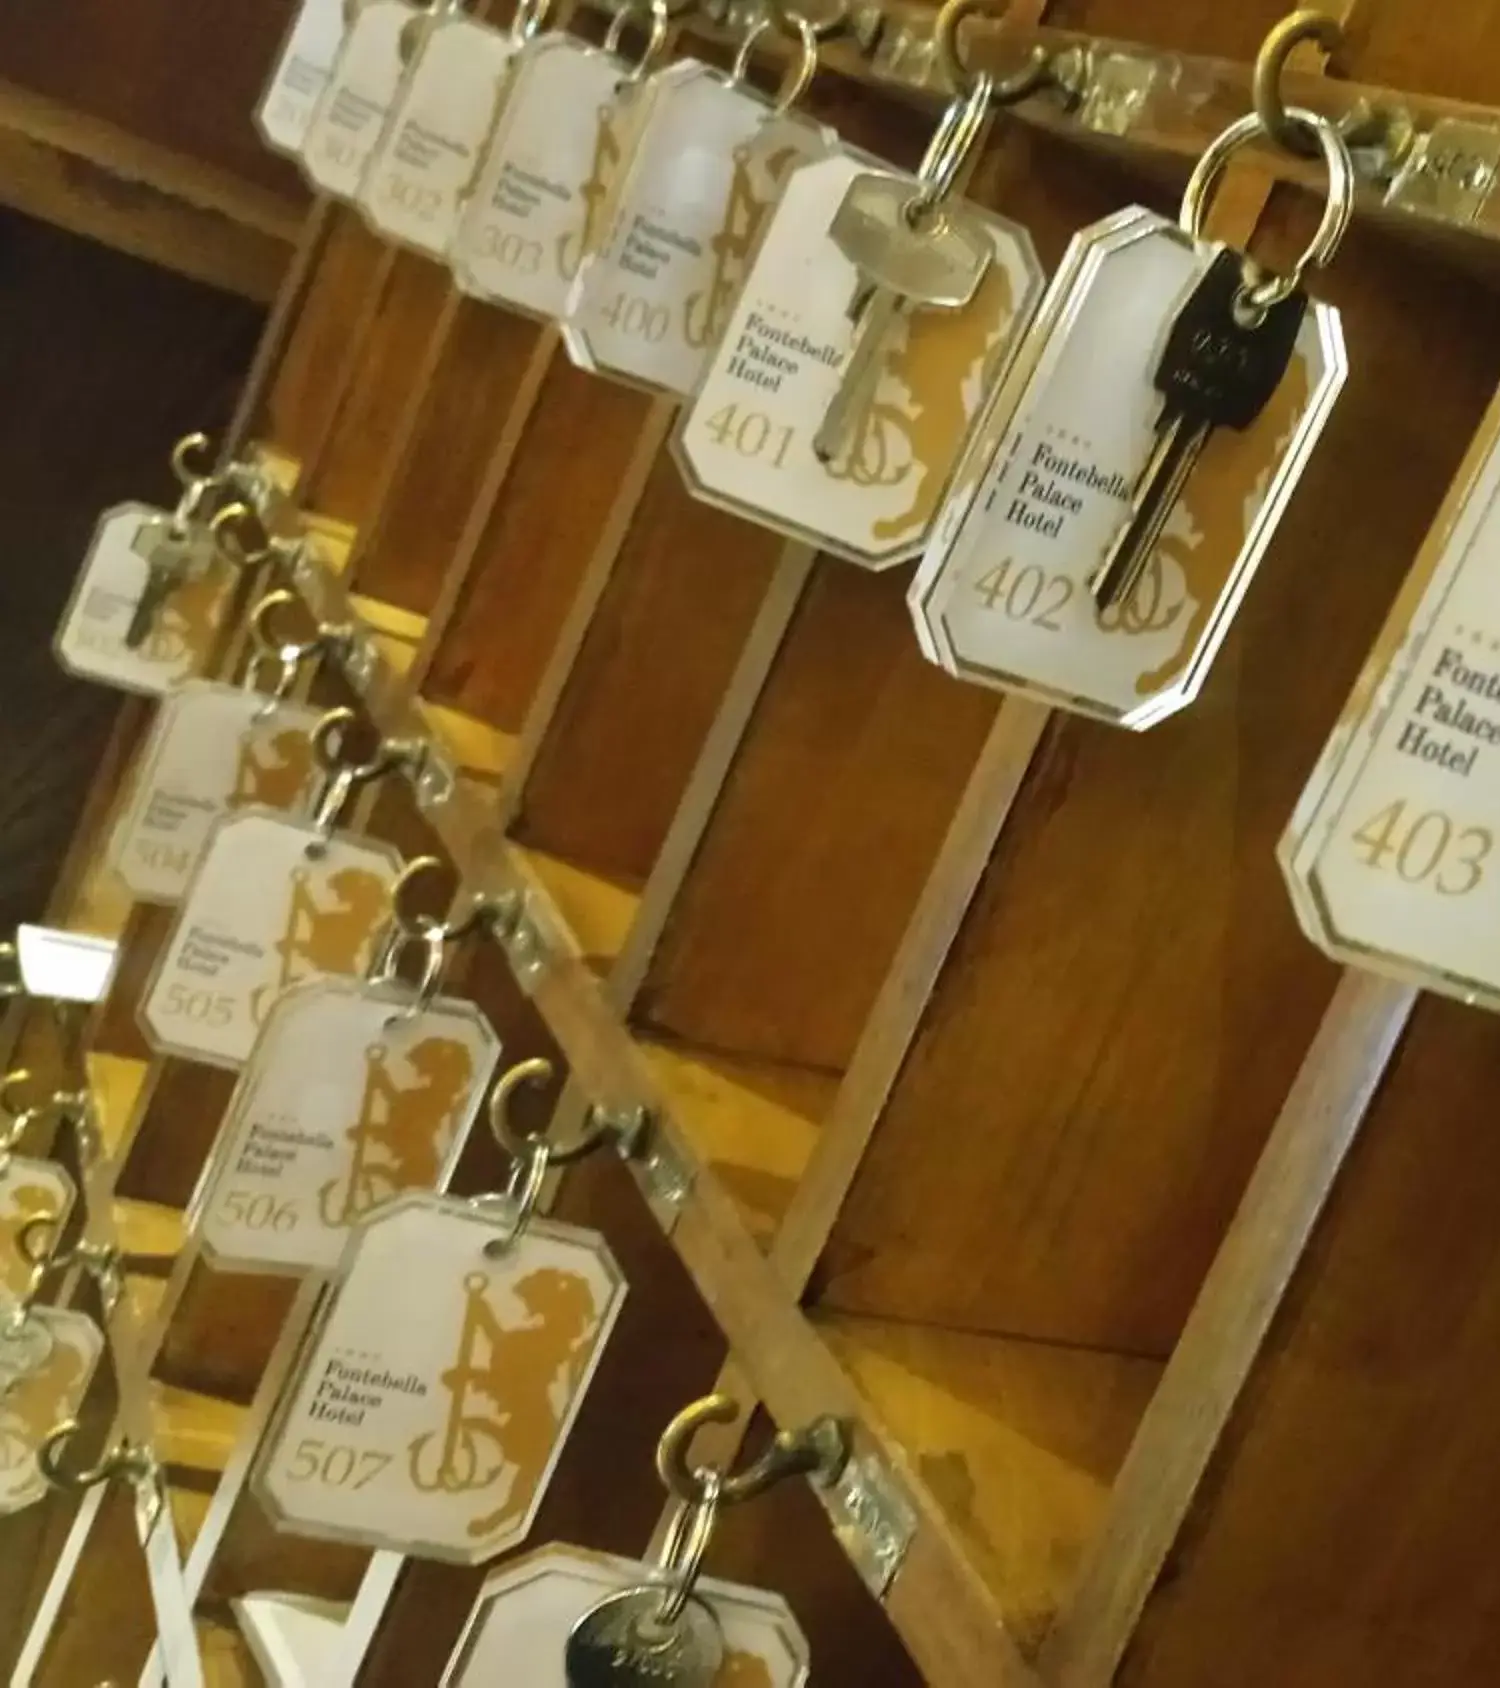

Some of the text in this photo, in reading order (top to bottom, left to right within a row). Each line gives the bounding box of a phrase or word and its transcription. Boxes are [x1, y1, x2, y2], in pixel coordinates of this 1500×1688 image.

[474, 224, 544, 275] 303
[601, 293, 670, 342] 400
[726, 356, 782, 394] Hotel
[735, 335, 799, 375] Palace
[704, 402, 795, 470] 401
[1017, 471, 1083, 515] Palace
[1005, 499, 1065, 539] Hotel
[973, 556, 1075, 632] 402
[1396, 719, 1479, 777] Hotel
[1351, 799, 1494, 897] 403
[158, 982, 236, 1029] 505
[215, 1190, 300, 1233] 506
[316, 1379, 384, 1408] Palace
[325, 1359, 427, 1397] Fontebella
[308, 1399, 366, 1427] Hotel
[284, 1438, 396, 1491] 507
